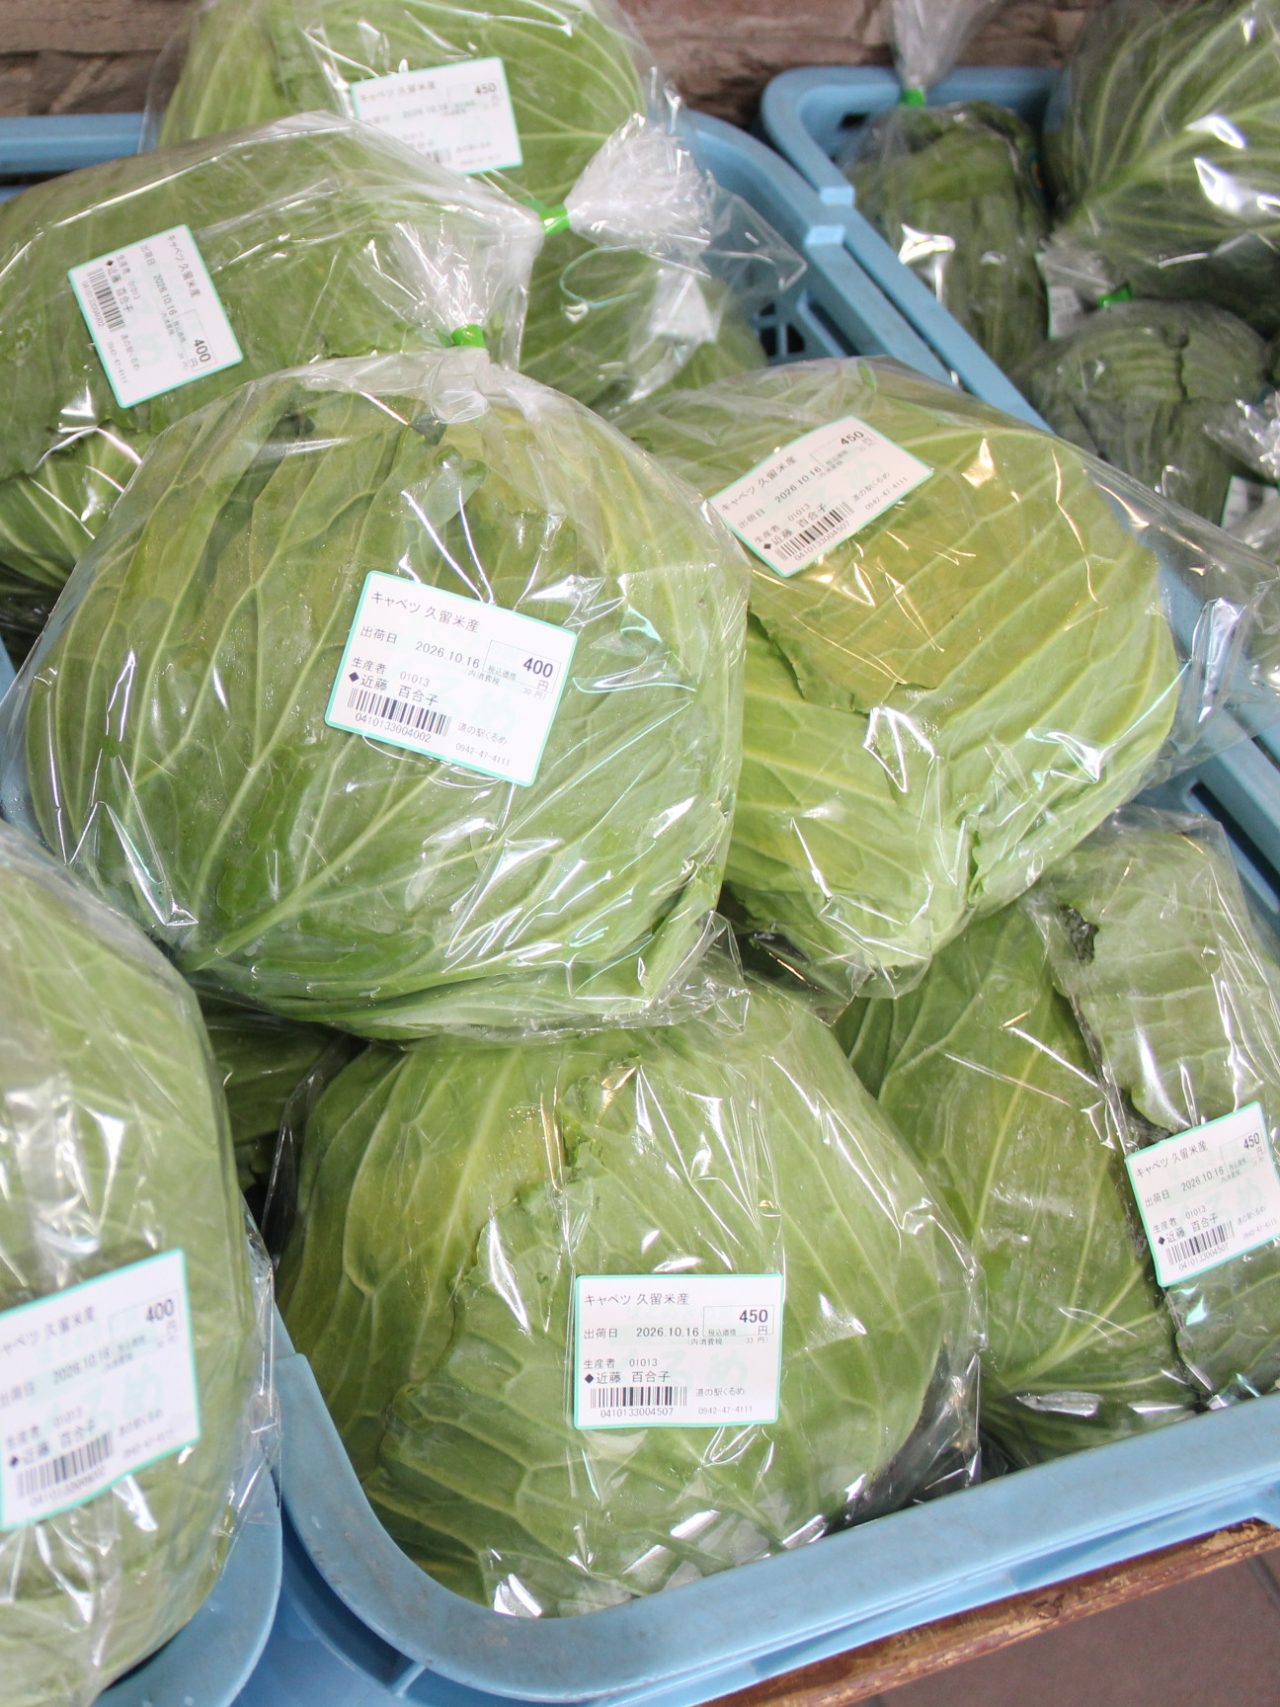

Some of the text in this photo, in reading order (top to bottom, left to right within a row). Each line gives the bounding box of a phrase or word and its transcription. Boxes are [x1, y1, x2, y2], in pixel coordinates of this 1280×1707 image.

[475, 83, 496, 95] 450
[168, 234, 200, 297] キャベツ 久留米産
[154, 275, 177, 315] 2026.10.16
[193, 339, 211, 362] 400
[840, 430, 865, 445] 450
[721, 486, 757, 510] キャベツ
[758, 459, 797, 486] 久留米産
[774, 468, 822, 500] 2026.10.16
[787, 505, 811, 519] 01013
[370, 591, 481, 633] キャベツ 久留米産
[360, 627, 480, 669] 出荷日 2026.10.16
[351, 657, 430, 686] 生産者 01013
[522, 658, 554, 678] 400
[360, 675, 439, 704] 近藤 百合子
[537, 680, 549, 690] 円
[356, 714, 431, 742] 0410133004002
[458, 723, 507, 745] 道の駅くるめ
[1243, 1133, 1260, 1149] 450
[1137, 1157, 1169, 1178] キャベツ
[1172, 1142, 1207, 1164] 久留米産
[1145, 1191, 1169, 1206] 出荷日
[1181, 1168, 1223, 1190] 2026.10.16
[1191, 1215, 1218, 1230] 百合子
[584, 1293, 688, 1306] キャベツ 久留米産
[147, 1299, 173, 1324] 400
[739, 1309, 768, 1323] 450
[583, 1326, 699, 1338] 出荷日 2026.10.16
[757, 1326, 767, 1334] 円
[584, 1358, 657, 1369] 生産者 01013
[596, 1370, 670, 1383] 近藤 百合子
[696, 1387, 744, 1396] 道の駅くるめ
[601, 1407, 673, 1417] 0410133004507
[698, 1406, 752, 1414] 0942-47-4111
